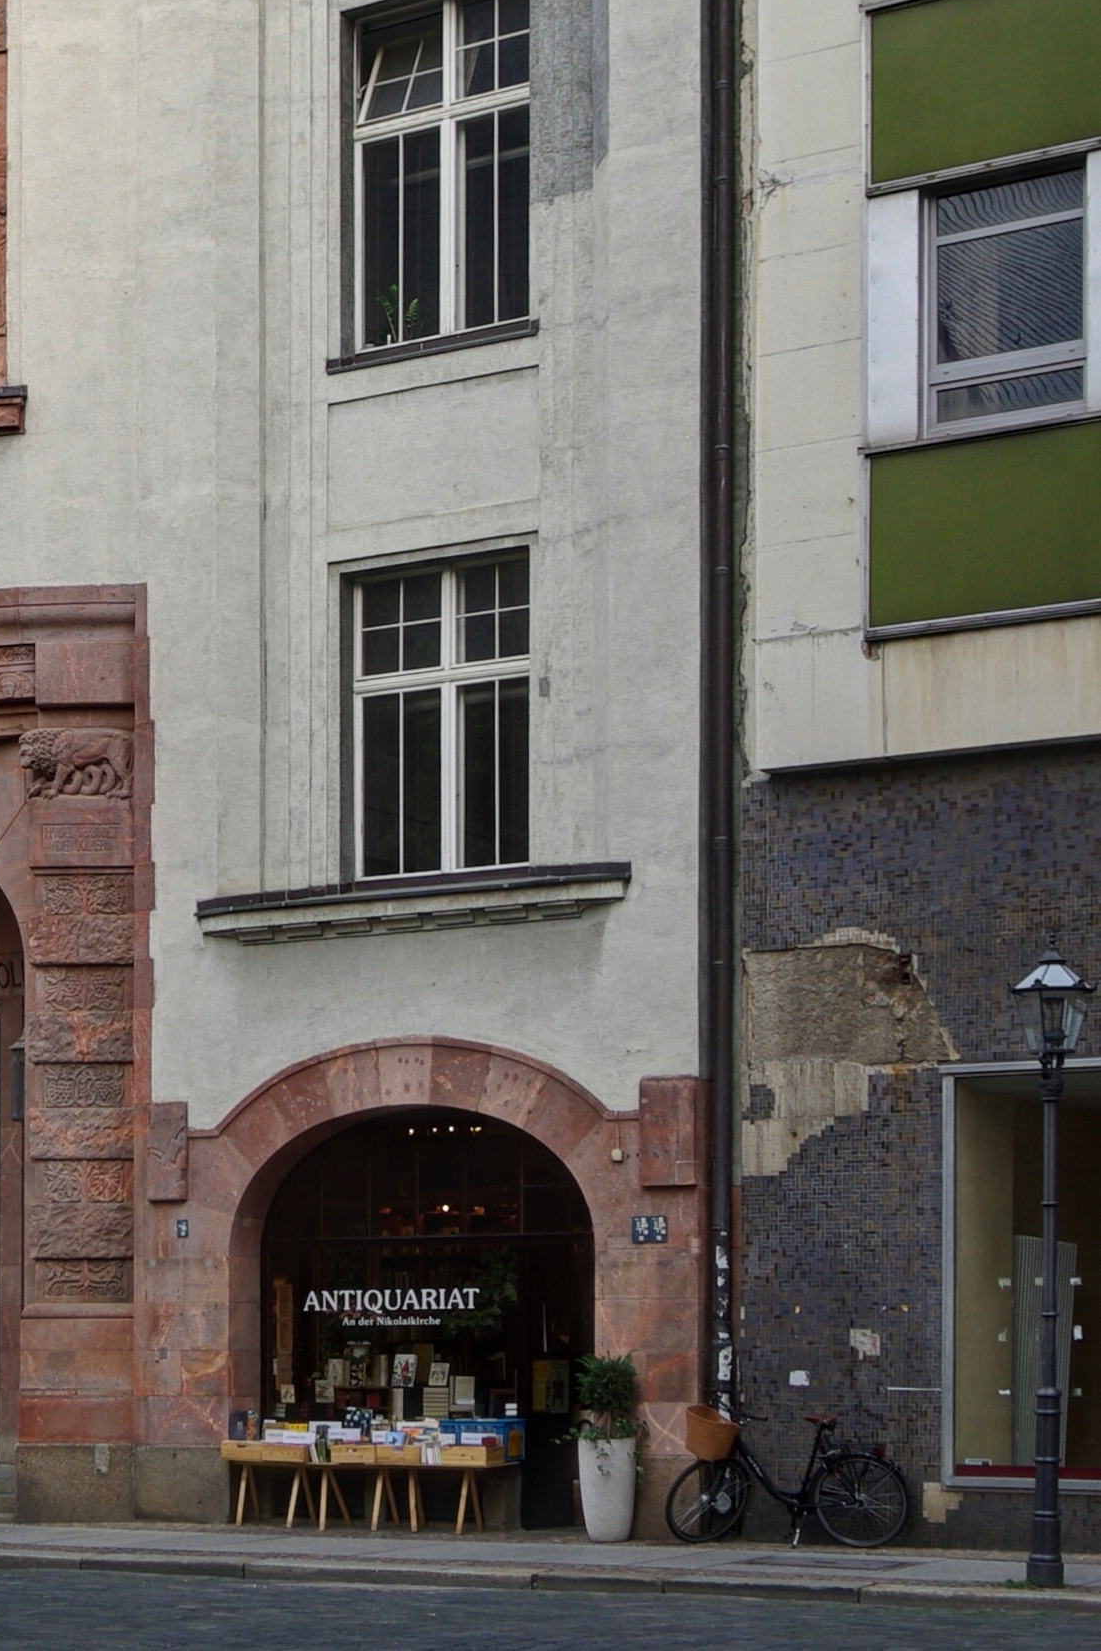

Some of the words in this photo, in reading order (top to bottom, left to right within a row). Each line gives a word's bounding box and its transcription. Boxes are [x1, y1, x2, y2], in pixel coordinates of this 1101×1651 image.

[303, 1287, 481, 1314] ANTIQUARIAT
[342, 1317, 356, 1326] An
[357, 1317, 374, 1326] der
[376, 1315, 442, 1326] Nikolaikirche
